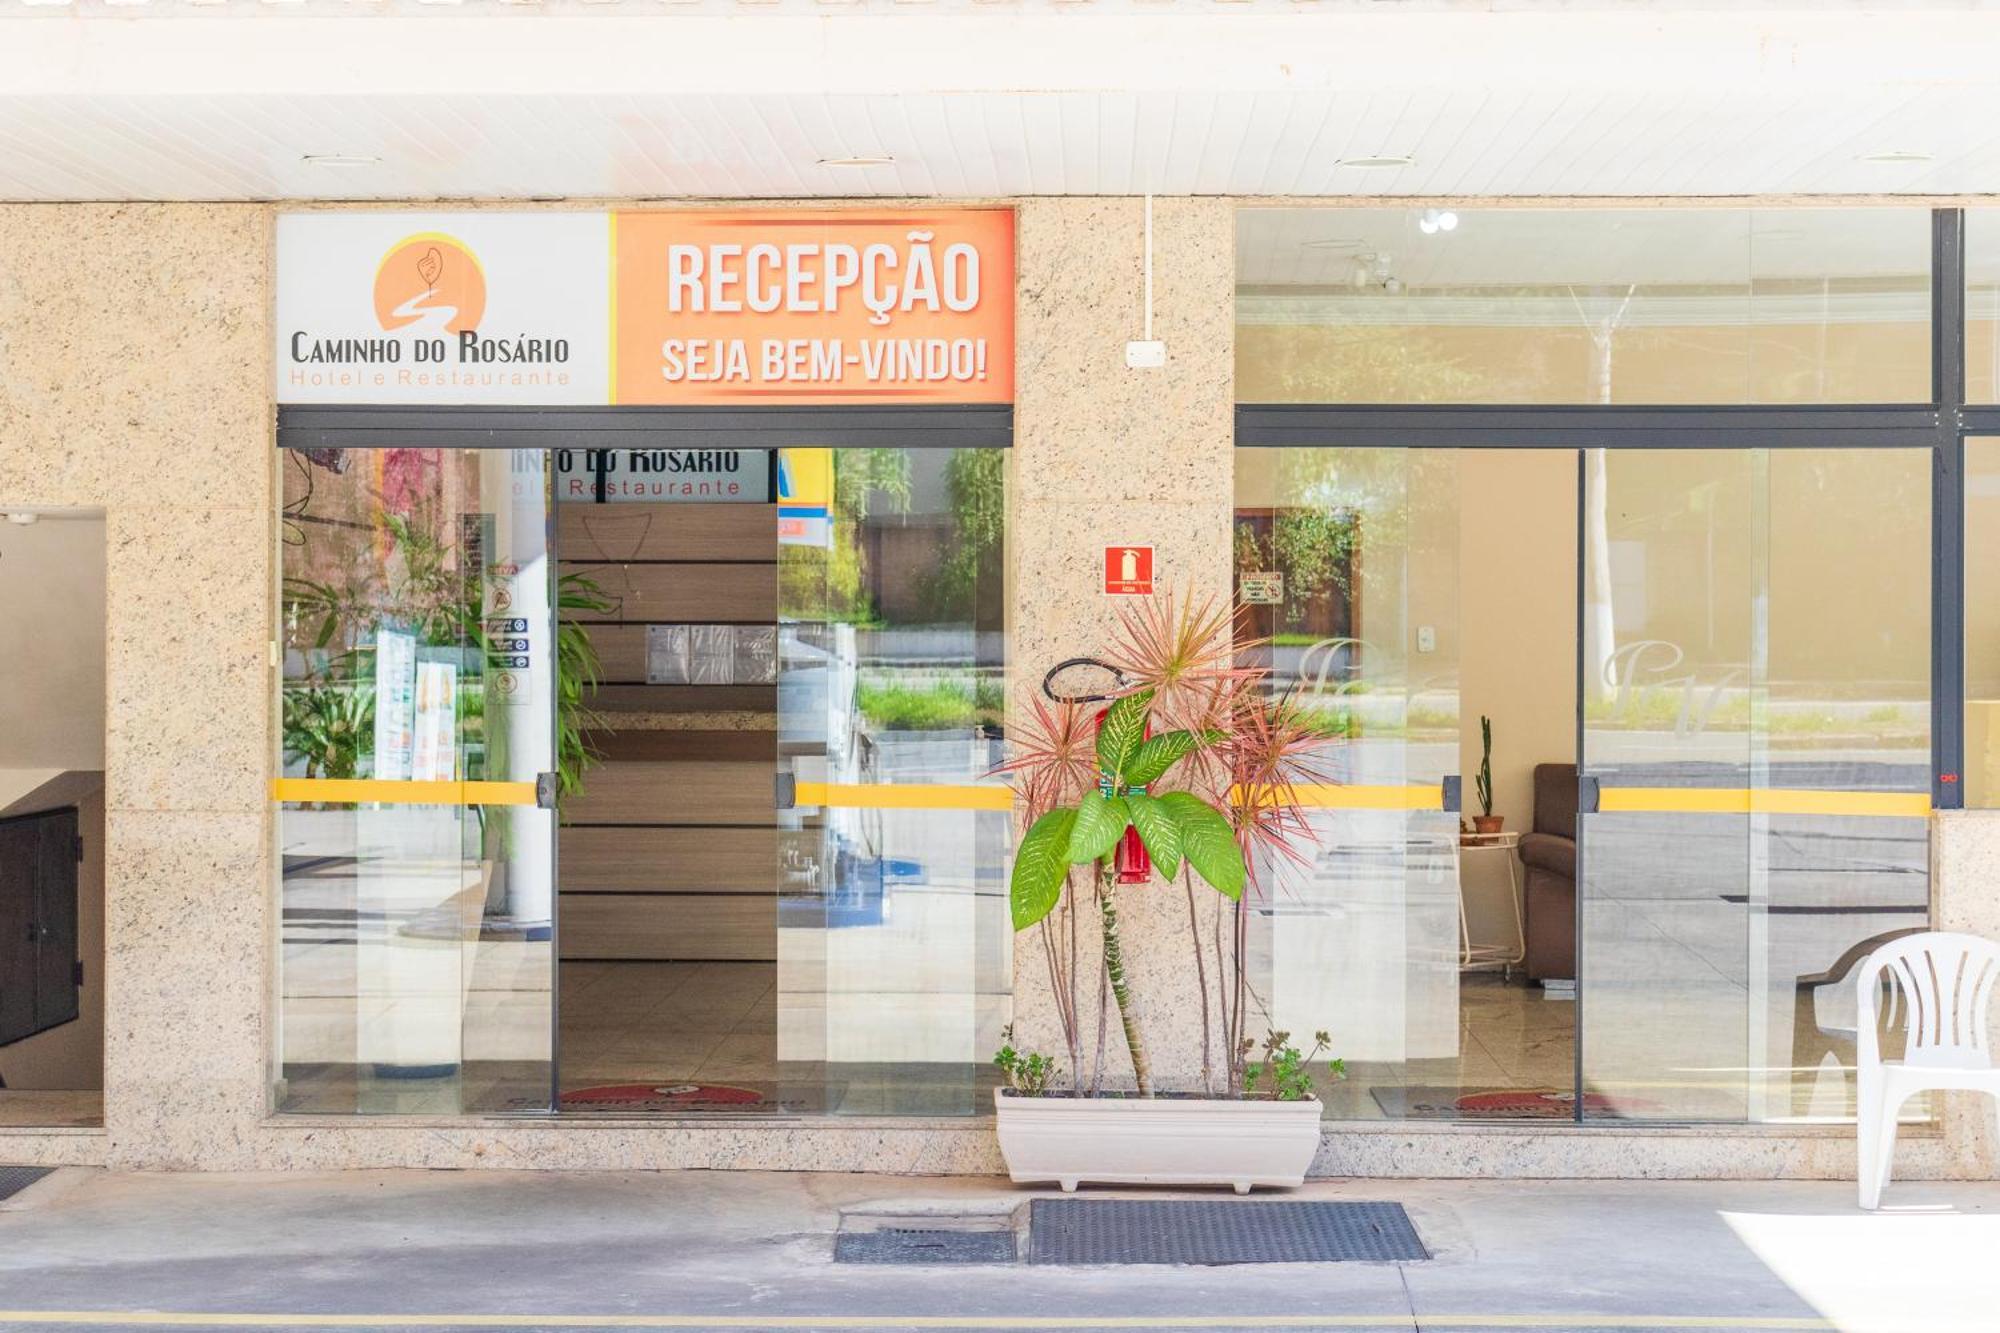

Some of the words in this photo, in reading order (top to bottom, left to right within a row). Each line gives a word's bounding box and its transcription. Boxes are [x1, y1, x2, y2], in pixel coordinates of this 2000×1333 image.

[668, 230, 980, 325] RECEPÇÃO
[291, 330, 401, 364] CAMINHO
[414, 339, 445, 363] DO
[459, 330, 569, 364] ROSÁRIO
[662, 338, 750, 381] SEJA
[762, 338, 986, 381] BEM-VINDO!
[291, 369, 362, 386] Hotel
[374, 372, 385, 386] e
[398, 369, 570, 386] Restaurante
